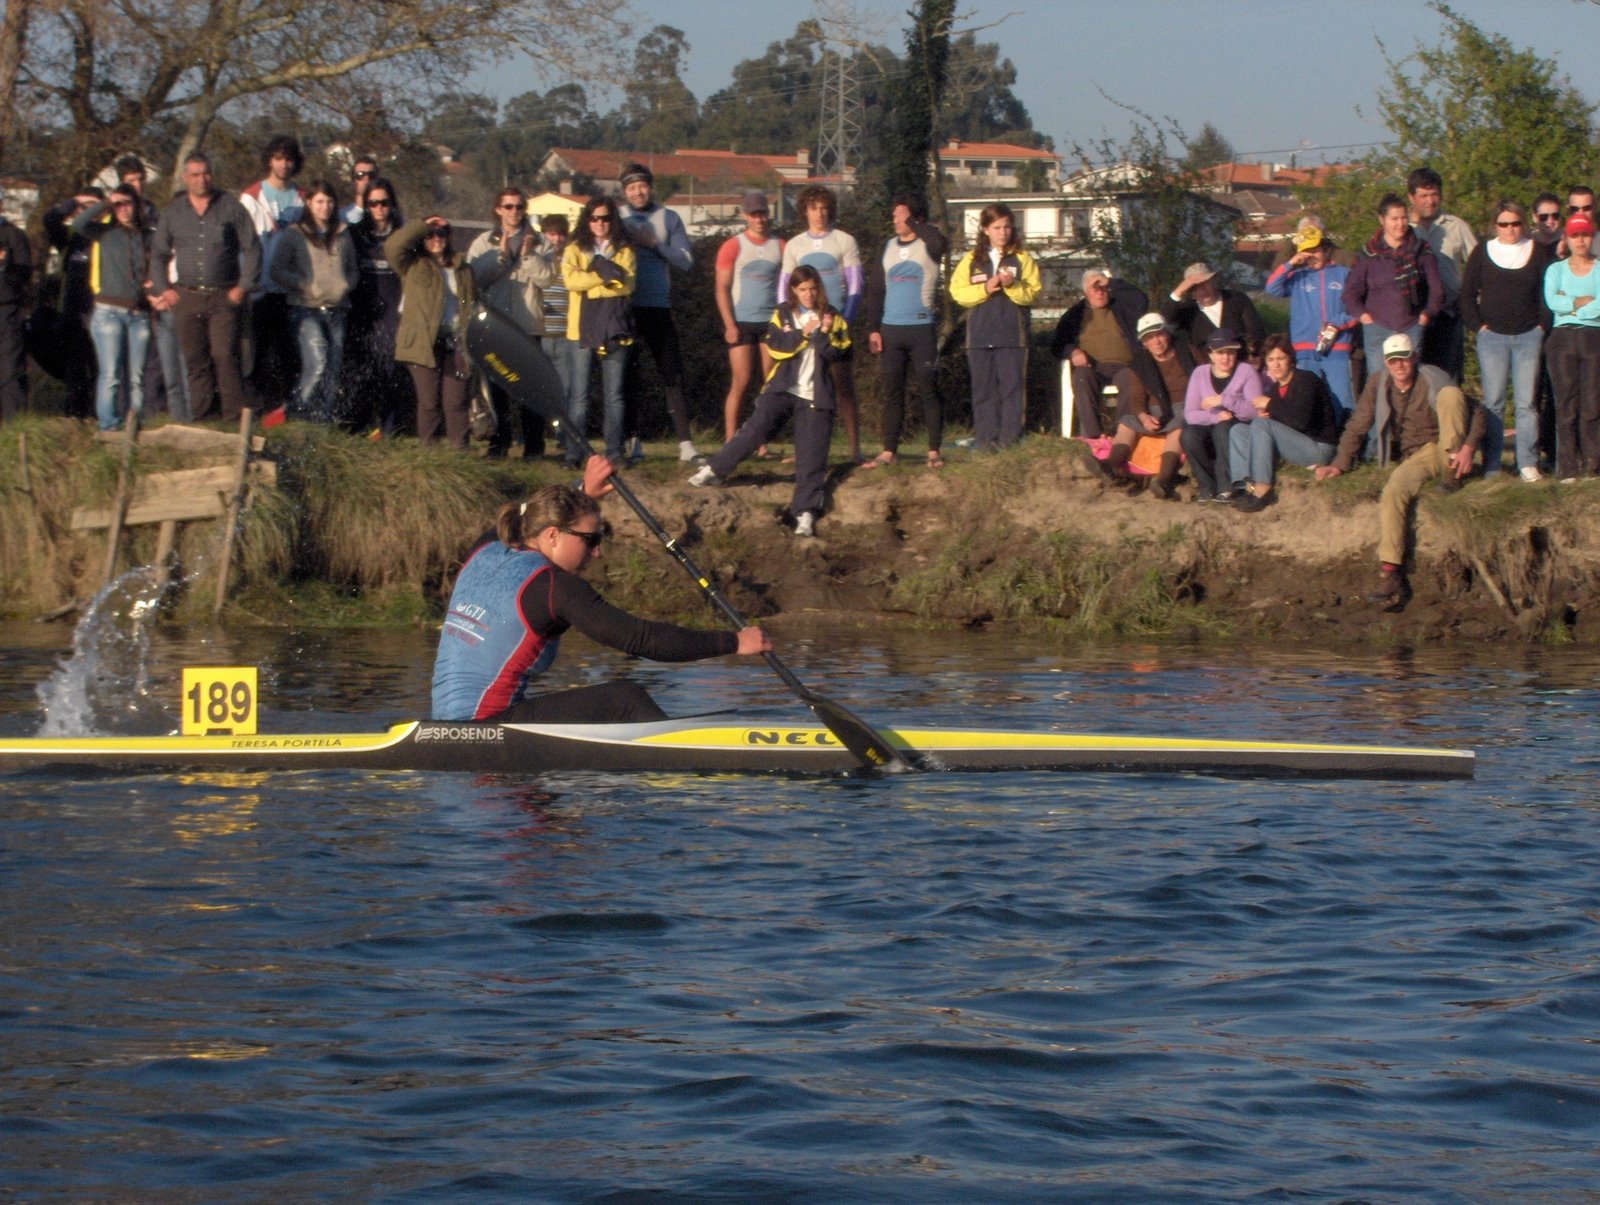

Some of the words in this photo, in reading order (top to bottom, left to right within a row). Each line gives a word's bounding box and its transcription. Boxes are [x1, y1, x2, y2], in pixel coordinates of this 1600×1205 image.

[187, 681, 251, 724] 189
[414, 726, 505, 743] ESPOSENDE
[748, 731, 839, 745] NEL
[231, 740, 278, 748] TERESA
[283, 738, 342, 747] PORTELA
